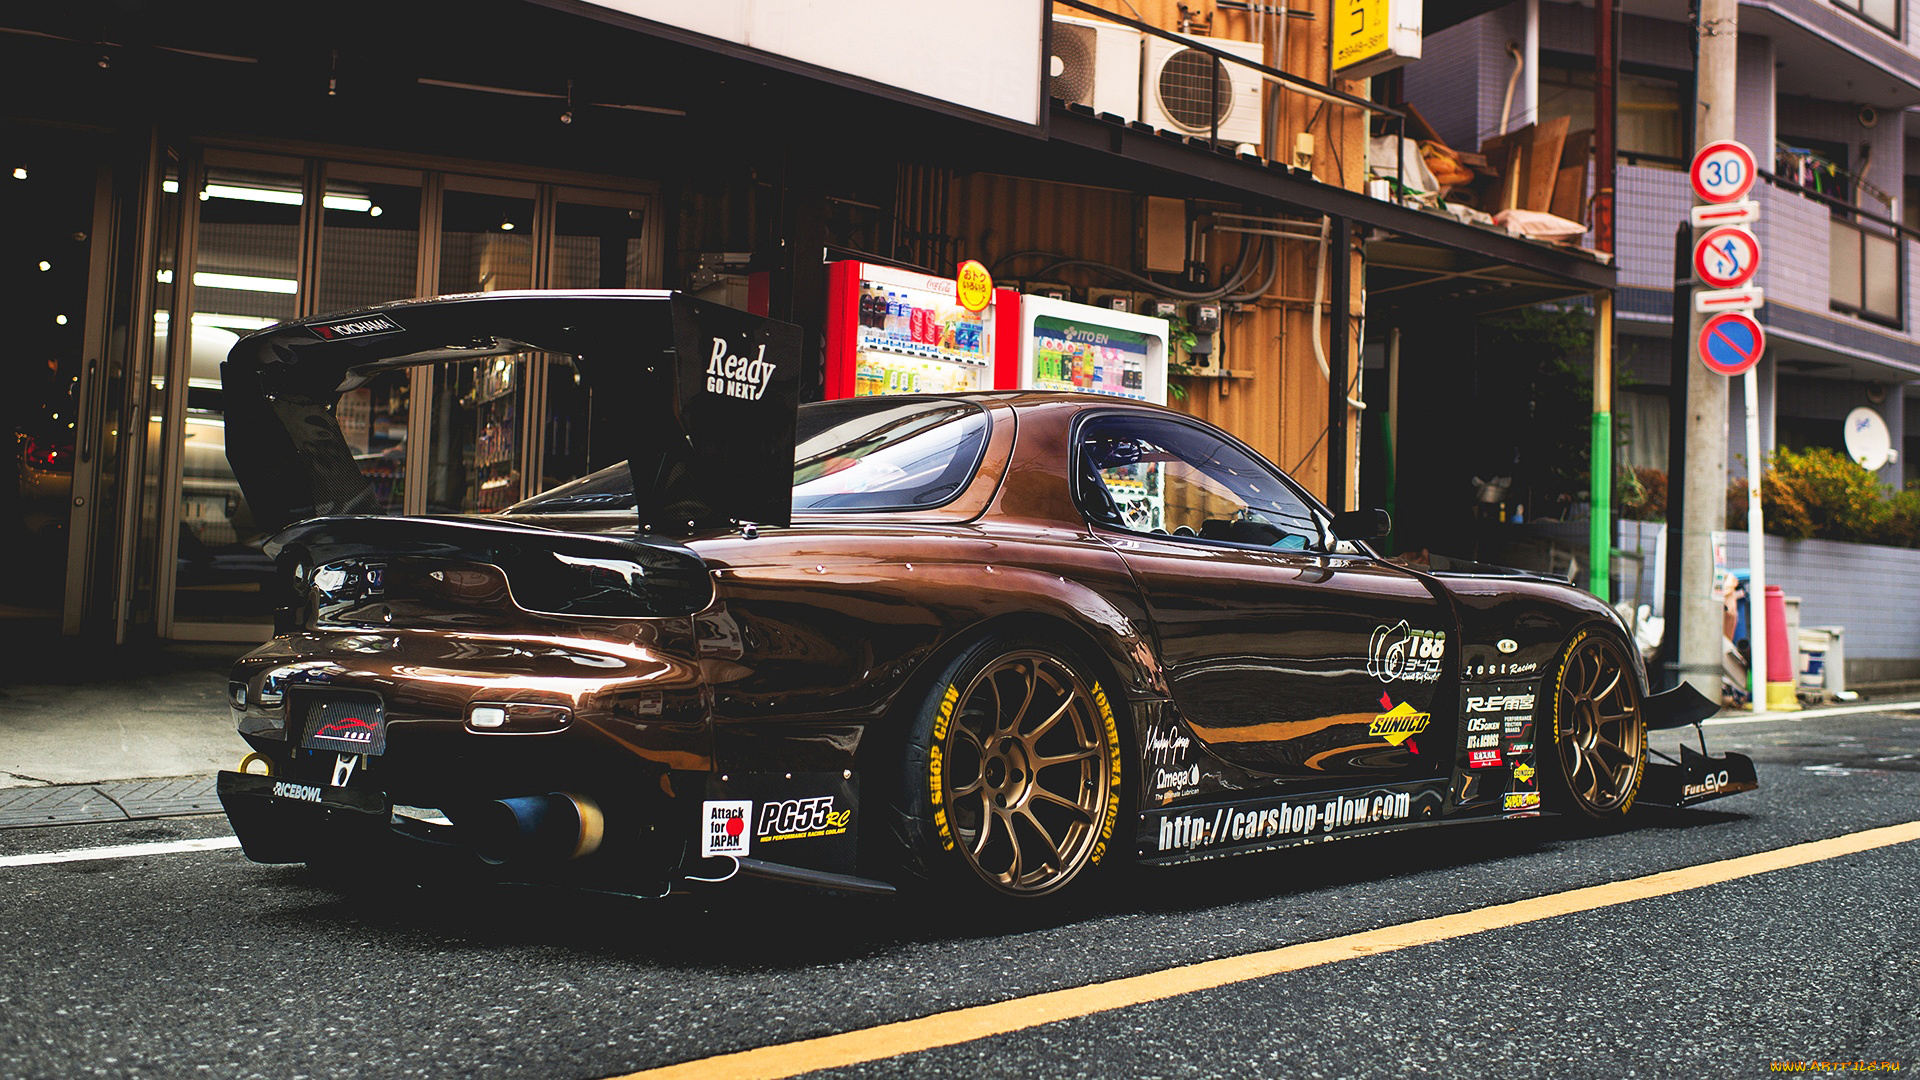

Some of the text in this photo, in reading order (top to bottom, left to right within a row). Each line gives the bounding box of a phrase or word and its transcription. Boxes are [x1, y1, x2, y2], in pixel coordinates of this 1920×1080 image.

[1706, 159, 1741, 187] 30
[963, 269, 987, 282] おトク
[962, 280, 987, 293] いろいろ
[329, 318, 396, 336] YOKOHAMA
[1077, 329, 1109, 345] ITO EN
[706, 337, 776, 400] Ready
[706, 376, 757, 400] GO NEXT
[1509, 662, 1537, 676] Racing
[1092, 680, 1121, 787] YOKOHAMA
[1371, 714, 1429, 734] SUNOCO
[929, 683, 960, 851] CAR SHOP GLOW
[1514, 769, 1534, 778] SUNOCO
[275, 781, 323, 803] RICEBOWL
[711, 807, 744, 820] Attack
[757, 796, 834, 836] PG55
[1102, 791, 1120, 840] A050
[1158, 792, 1411, 851] http://carshop-glow.com
[711, 821, 725, 834] for
[710, 835, 740, 848] JAPAN
